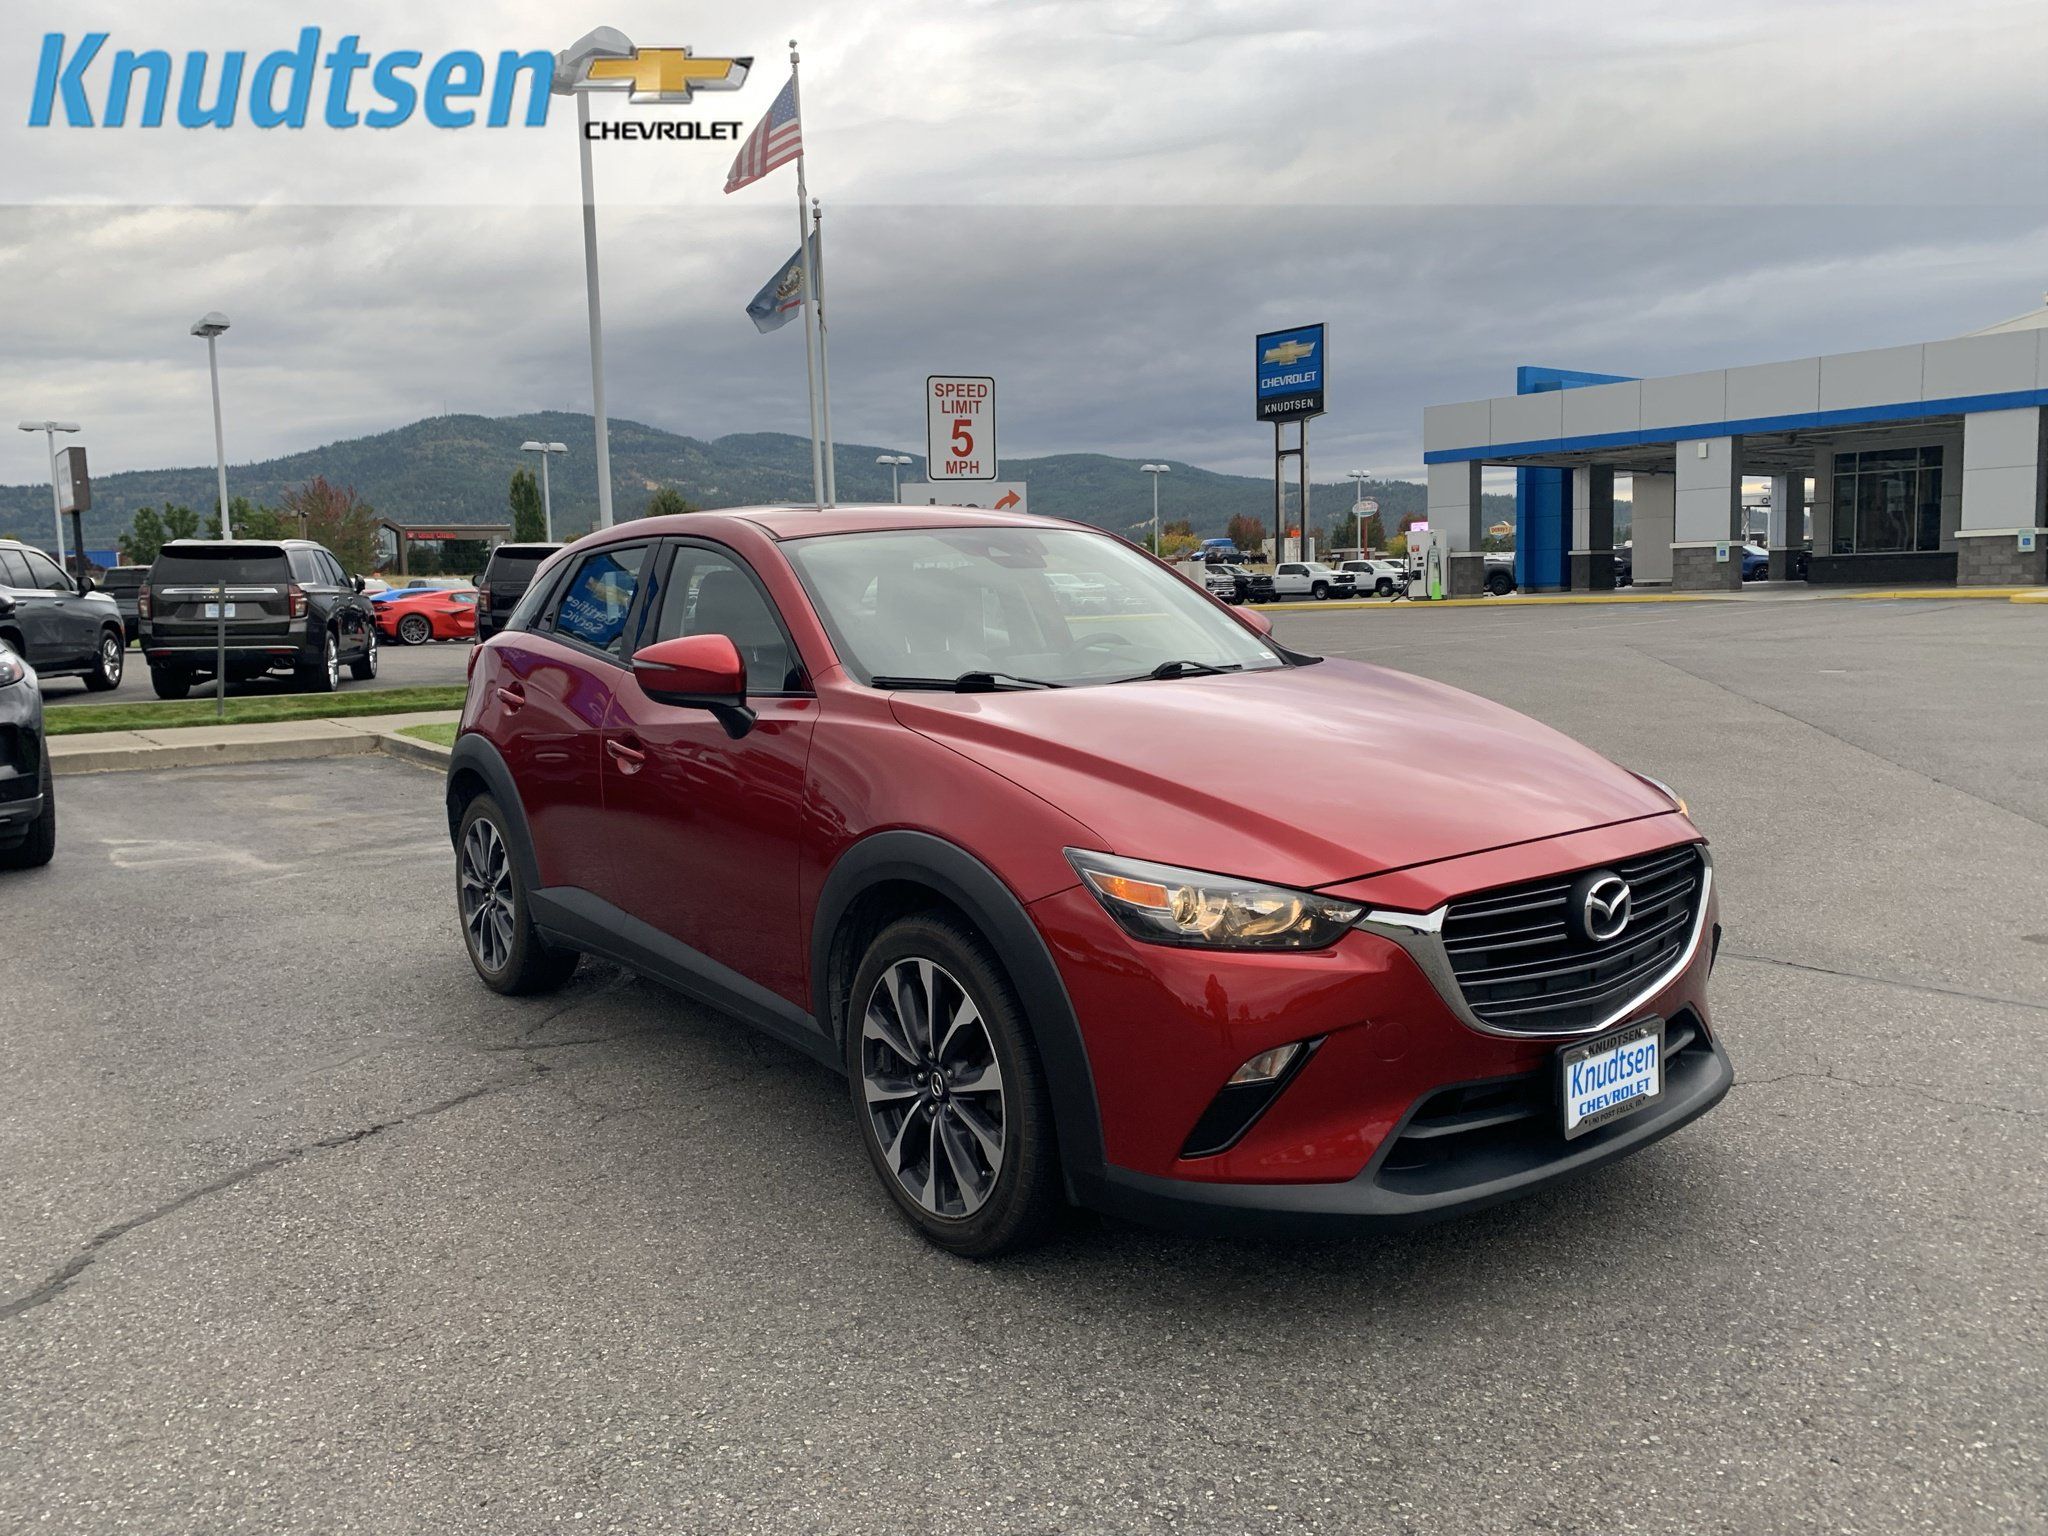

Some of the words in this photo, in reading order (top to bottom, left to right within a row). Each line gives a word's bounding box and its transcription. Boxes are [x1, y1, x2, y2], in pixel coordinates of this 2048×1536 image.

[1261, 371, 1317, 389] CHEVROLET
[934, 383, 988, 398] SPEED
[941, 400, 982, 414] LIMIT
[1264, 398, 1314, 414] KNUDTSEN
[951, 419, 974, 457] 5
[945, 461, 980, 474] MPH
[1588, 1029, 1643, 1055] KNUDTSEN
[1571, 1043, 1655, 1098] Knudtsen
[1579, 1077, 1650, 1116] CHEVROLET
[1600, 1109, 1615, 1121] POST
